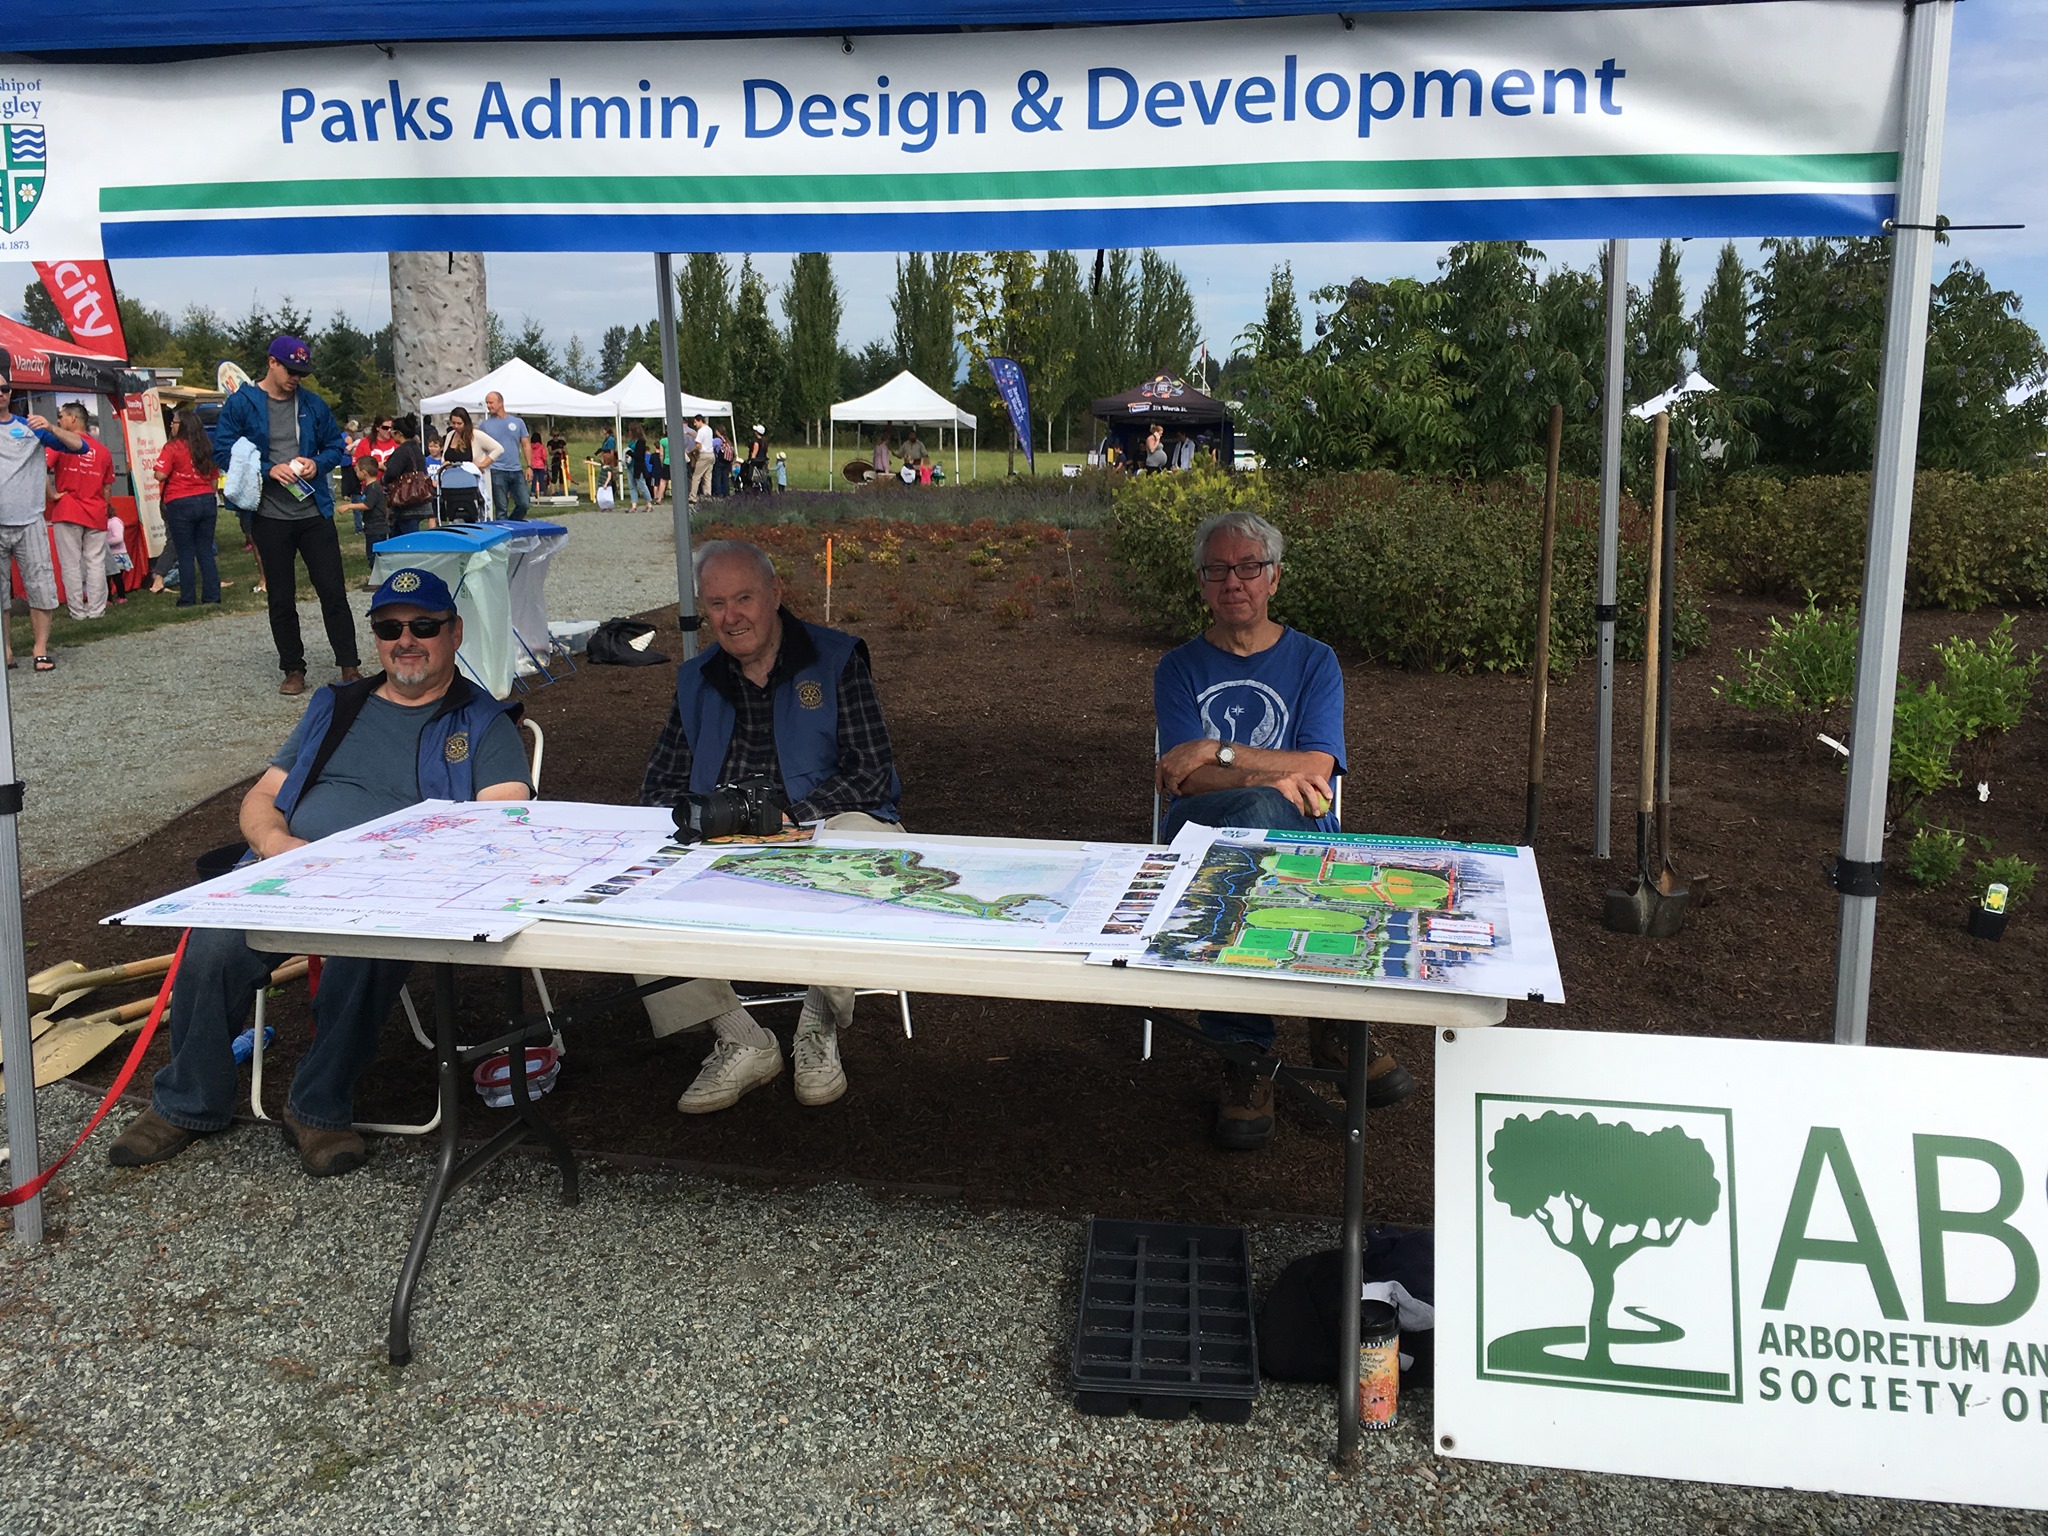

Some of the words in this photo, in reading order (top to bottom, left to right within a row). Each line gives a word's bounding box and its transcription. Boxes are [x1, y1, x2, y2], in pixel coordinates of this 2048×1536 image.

[0, 78, 25, 94] hip
[27, 79, 41, 91] of
[0, 95, 42, 119] gley
[282, 80, 453, 144] Parks
[474, 78, 720, 148] Admin,
[744, 75, 987, 154] Design
[1012, 69, 1063, 133] &
[1088, 55, 1625, 138] Development
[10, 241, 30, 250] 1873
[14, 355, 46, 376] Vancity
[1281, 833, 1348, 842] Yorkson
[1354, 837, 1458, 848] Community
[1465, 844, 1508, 853] Park
[1761, 1126, 2048, 1326] AB
[1758, 1322, 1990, 1374] ARBORETUM
[1759, 1367, 1972, 1418] SOCIETY
